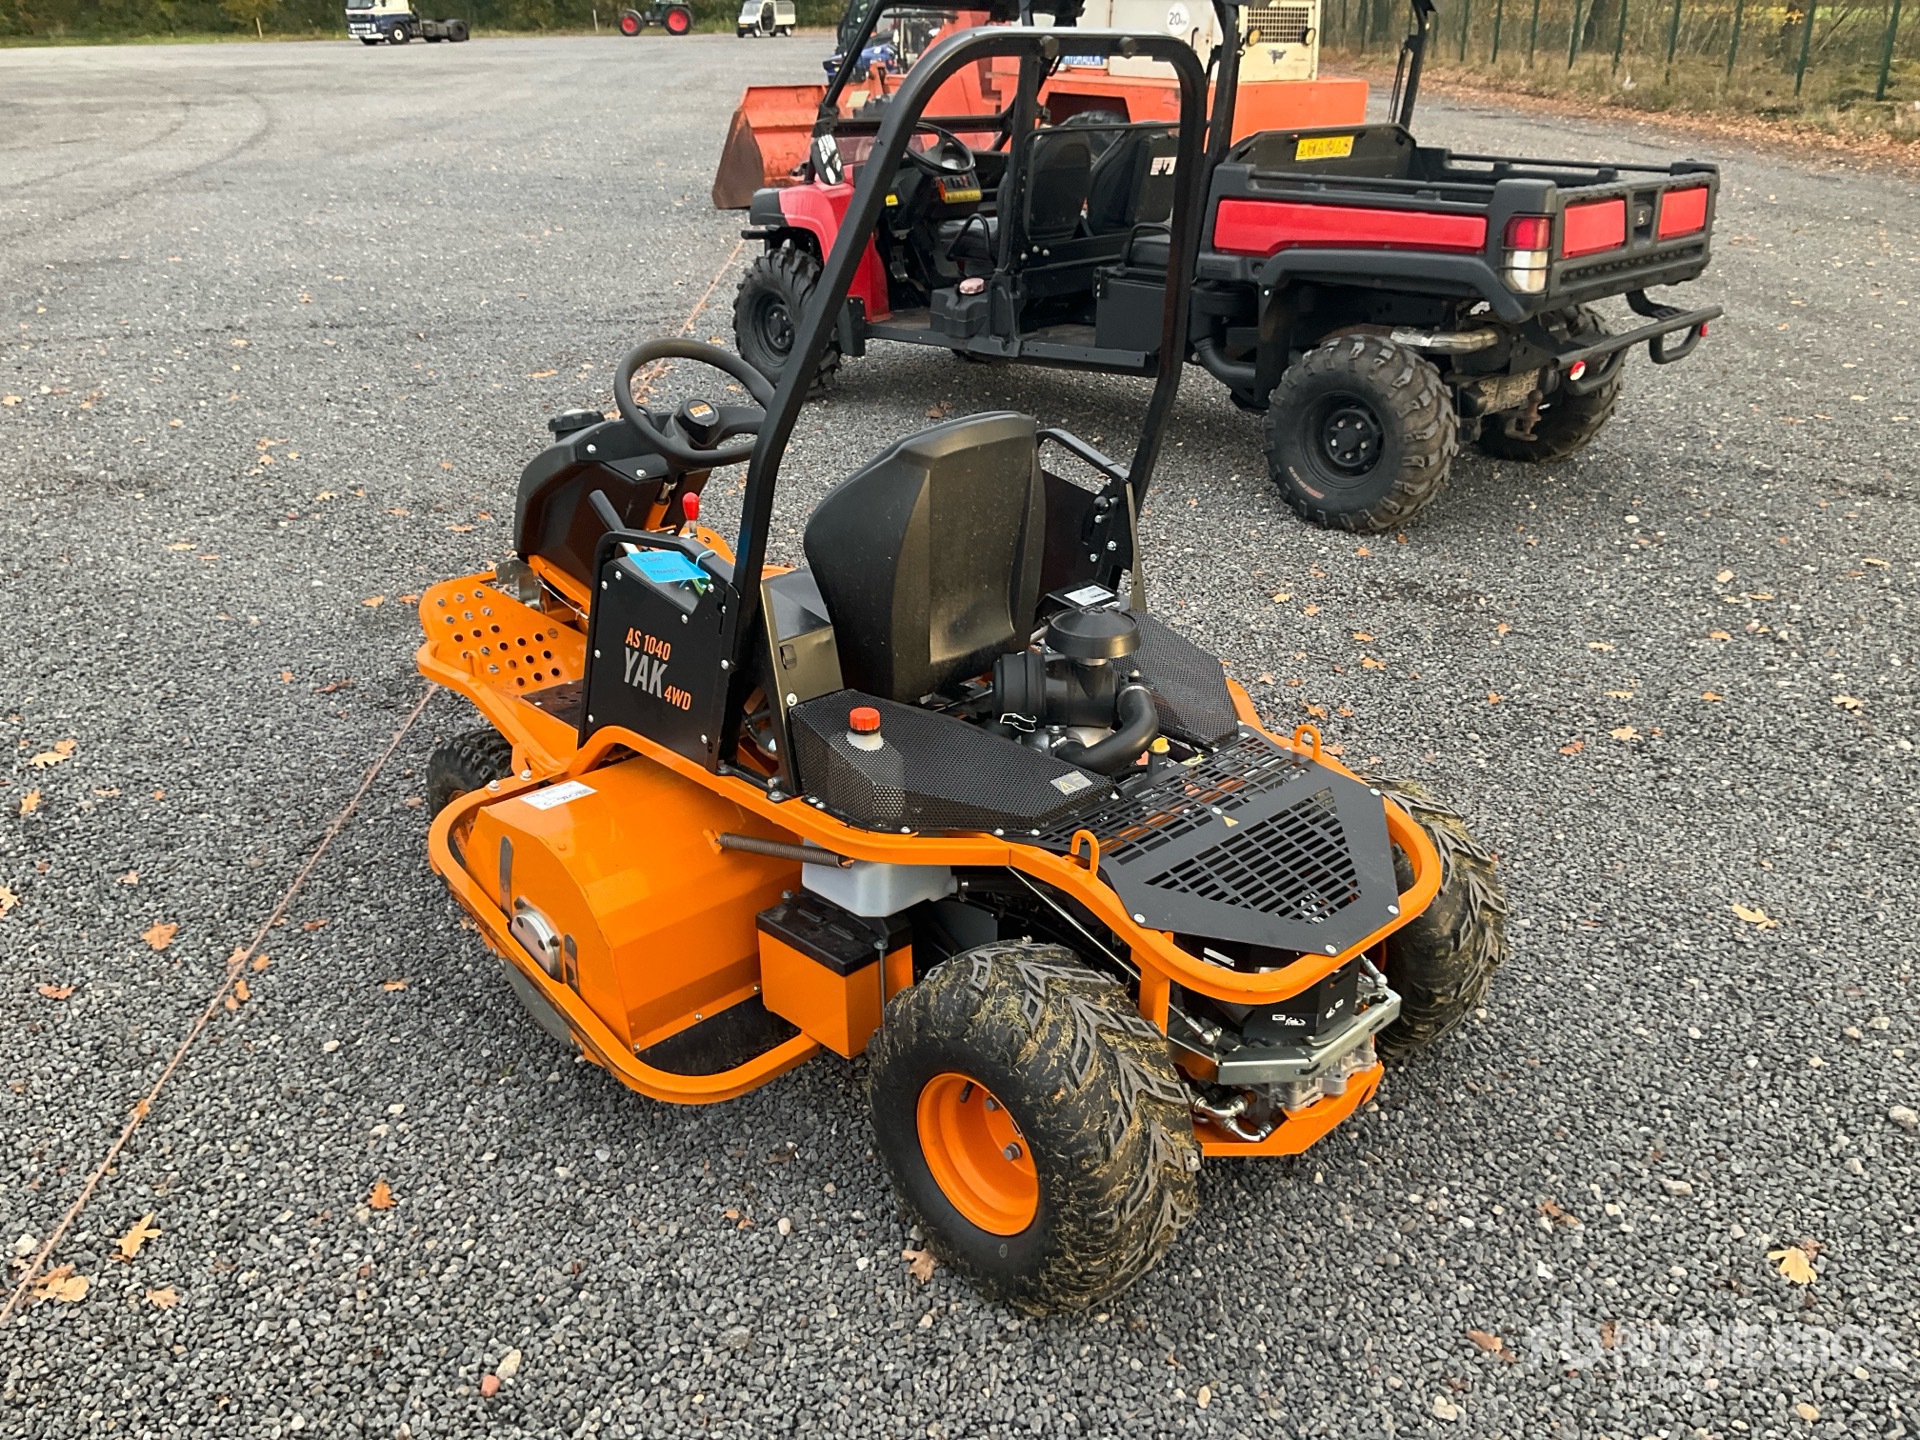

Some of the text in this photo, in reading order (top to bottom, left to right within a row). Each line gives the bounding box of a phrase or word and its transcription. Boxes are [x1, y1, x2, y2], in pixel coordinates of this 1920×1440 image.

[1169, 12, 1181, 26] 20
[625, 627, 672, 661] AS 1040
[623, 646, 692, 711] YAK 4WD
